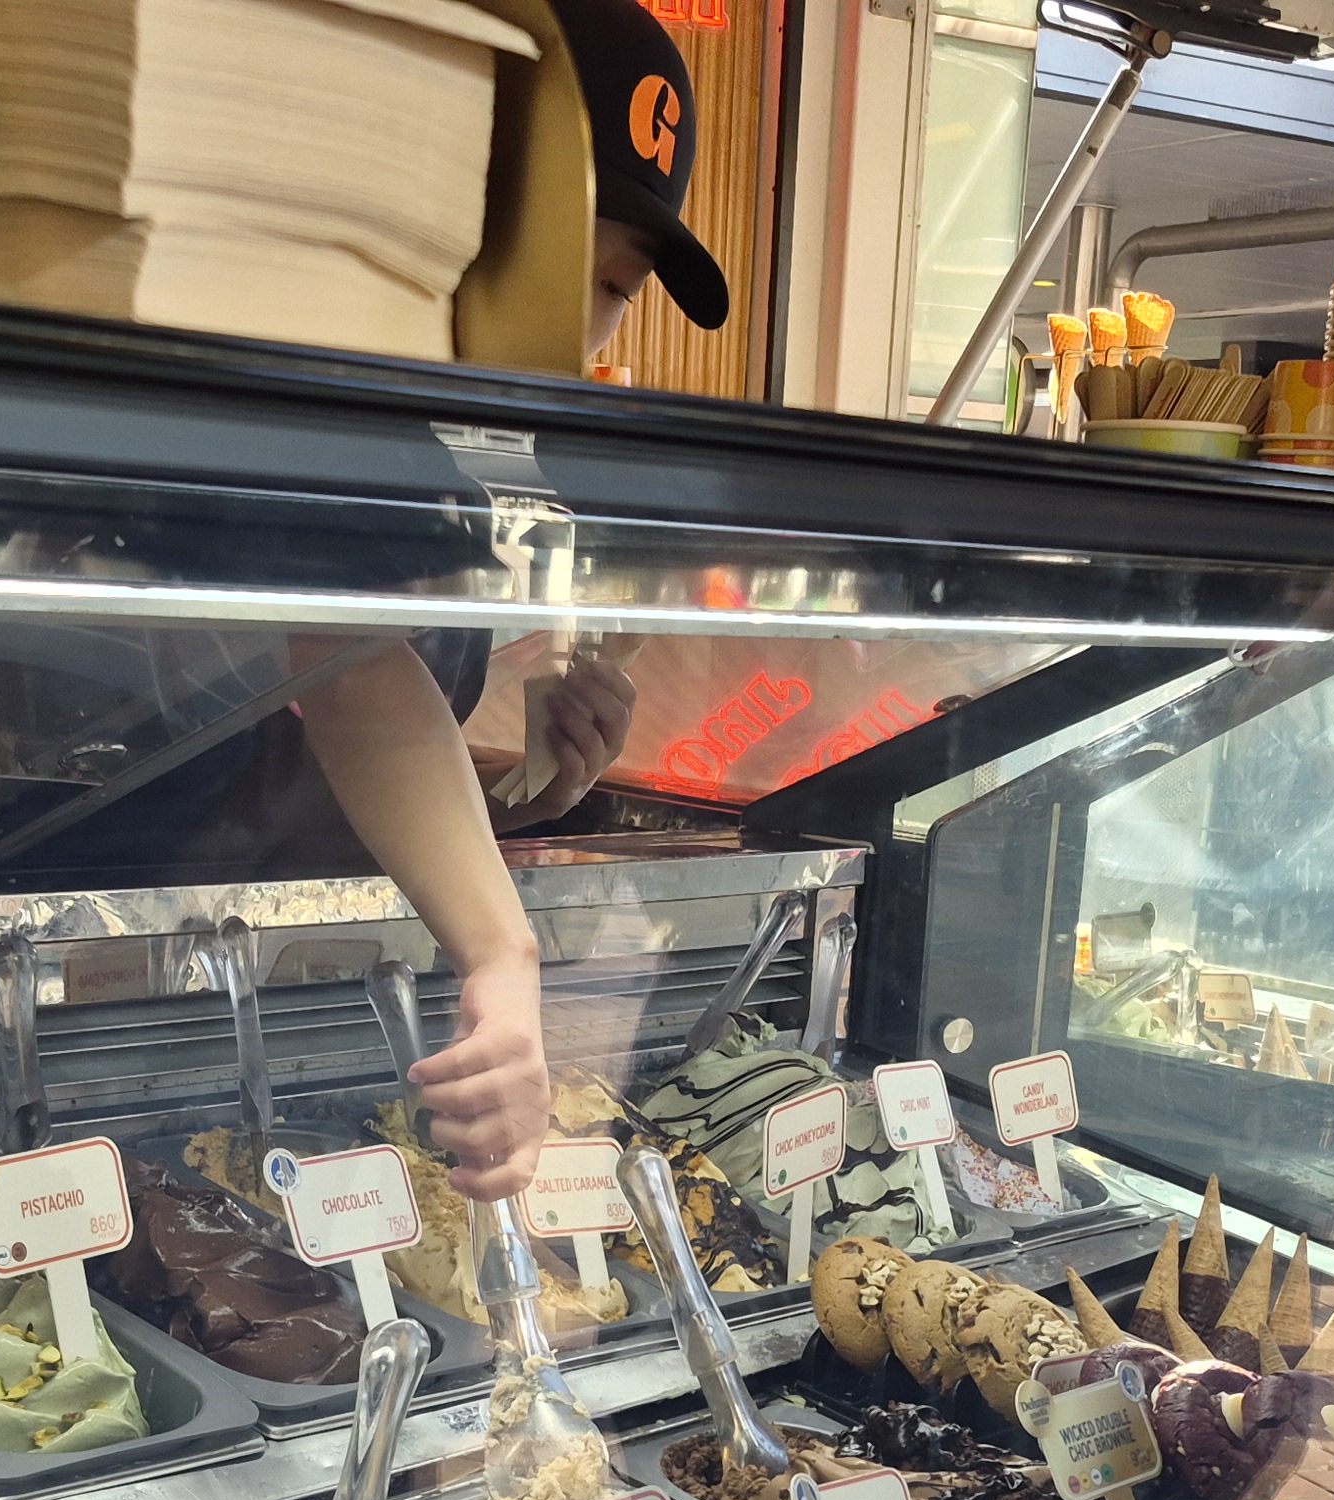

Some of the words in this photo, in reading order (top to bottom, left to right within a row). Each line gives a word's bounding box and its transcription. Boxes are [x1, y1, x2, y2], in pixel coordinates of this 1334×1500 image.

[628, 74, 682, 178] G
[1012, 1093, 1059, 1116] WONDERLAND
[1022, 1081, 1045, 1098] CANDY
[775, 1137, 794, 1157] CHOC
[794, 1121, 836, 1149] HONEYCOMB
[535, 1177, 572, 1194] SALTED
[573, 1175, 617, 1192] CARAMEL
[20, 1188, 85, 1219] PISTACHIO
[322, 1189, 383, 1215] CHOCOLATE
[1058, 1419, 1096, 1445] WICKED
[1094, 1408, 1132, 1434] DOUBLE
[1068, 1438, 1096, 1463] CHOC
[1094, 1427, 1136, 1454] BROWNIE
